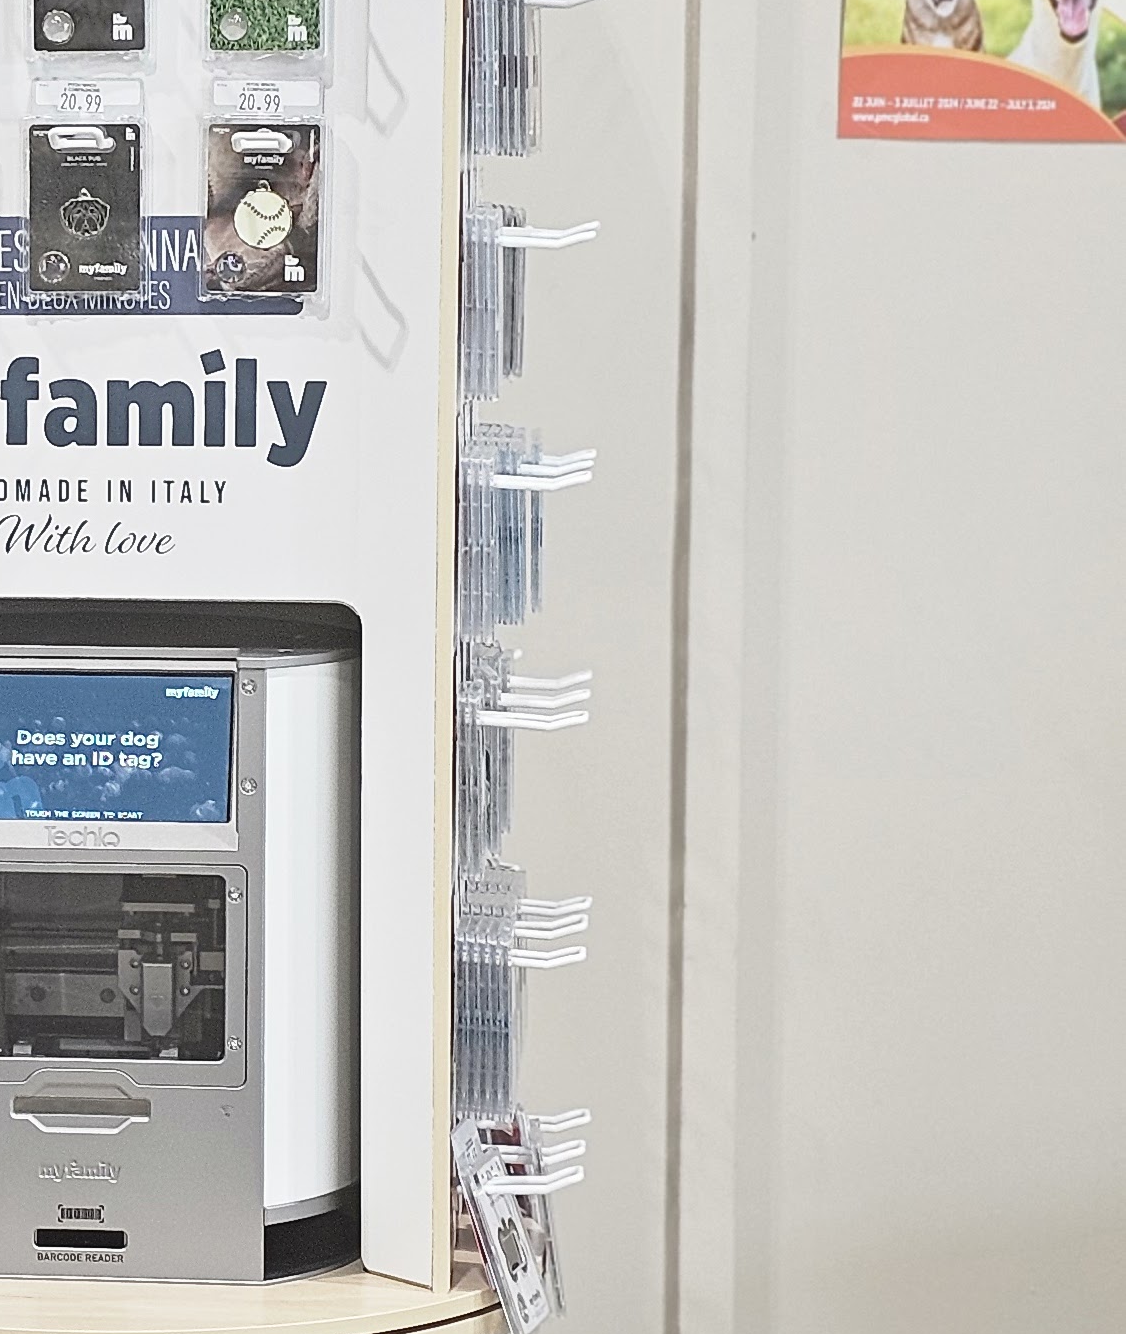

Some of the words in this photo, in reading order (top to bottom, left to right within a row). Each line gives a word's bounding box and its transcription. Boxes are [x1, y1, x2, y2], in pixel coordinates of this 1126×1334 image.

[61, 93, 102, 113] 20.99
[239, 93, 280, 113] 20.99
[243, 154, 284, 166] myfamily
[78, 262, 127, 276] myfamily
[107, 479, 132, 504] IN
[150, 479, 229, 504] ITALY
[106, 521, 176, 555] love
[165, 686, 220, 699] myfamily
[16, 729, 65, 746] Does
[70, 733, 116, 748] your
[120, 731, 160, 749] dog
[11, 750, 58, 766] have
[62, 752, 86, 766] an
[92, 751, 113, 766] ID
[119, 750, 163, 769] tag?
[25, 809, 51, 818] TOUCH
[54, 809, 69, 818] THE
[103, 811, 115, 819] TO
[38, 1159, 121, 1184] myfamily
[37, 1252, 83, 1262] BARCODE
[85, 1253, 124, 1263] READER
